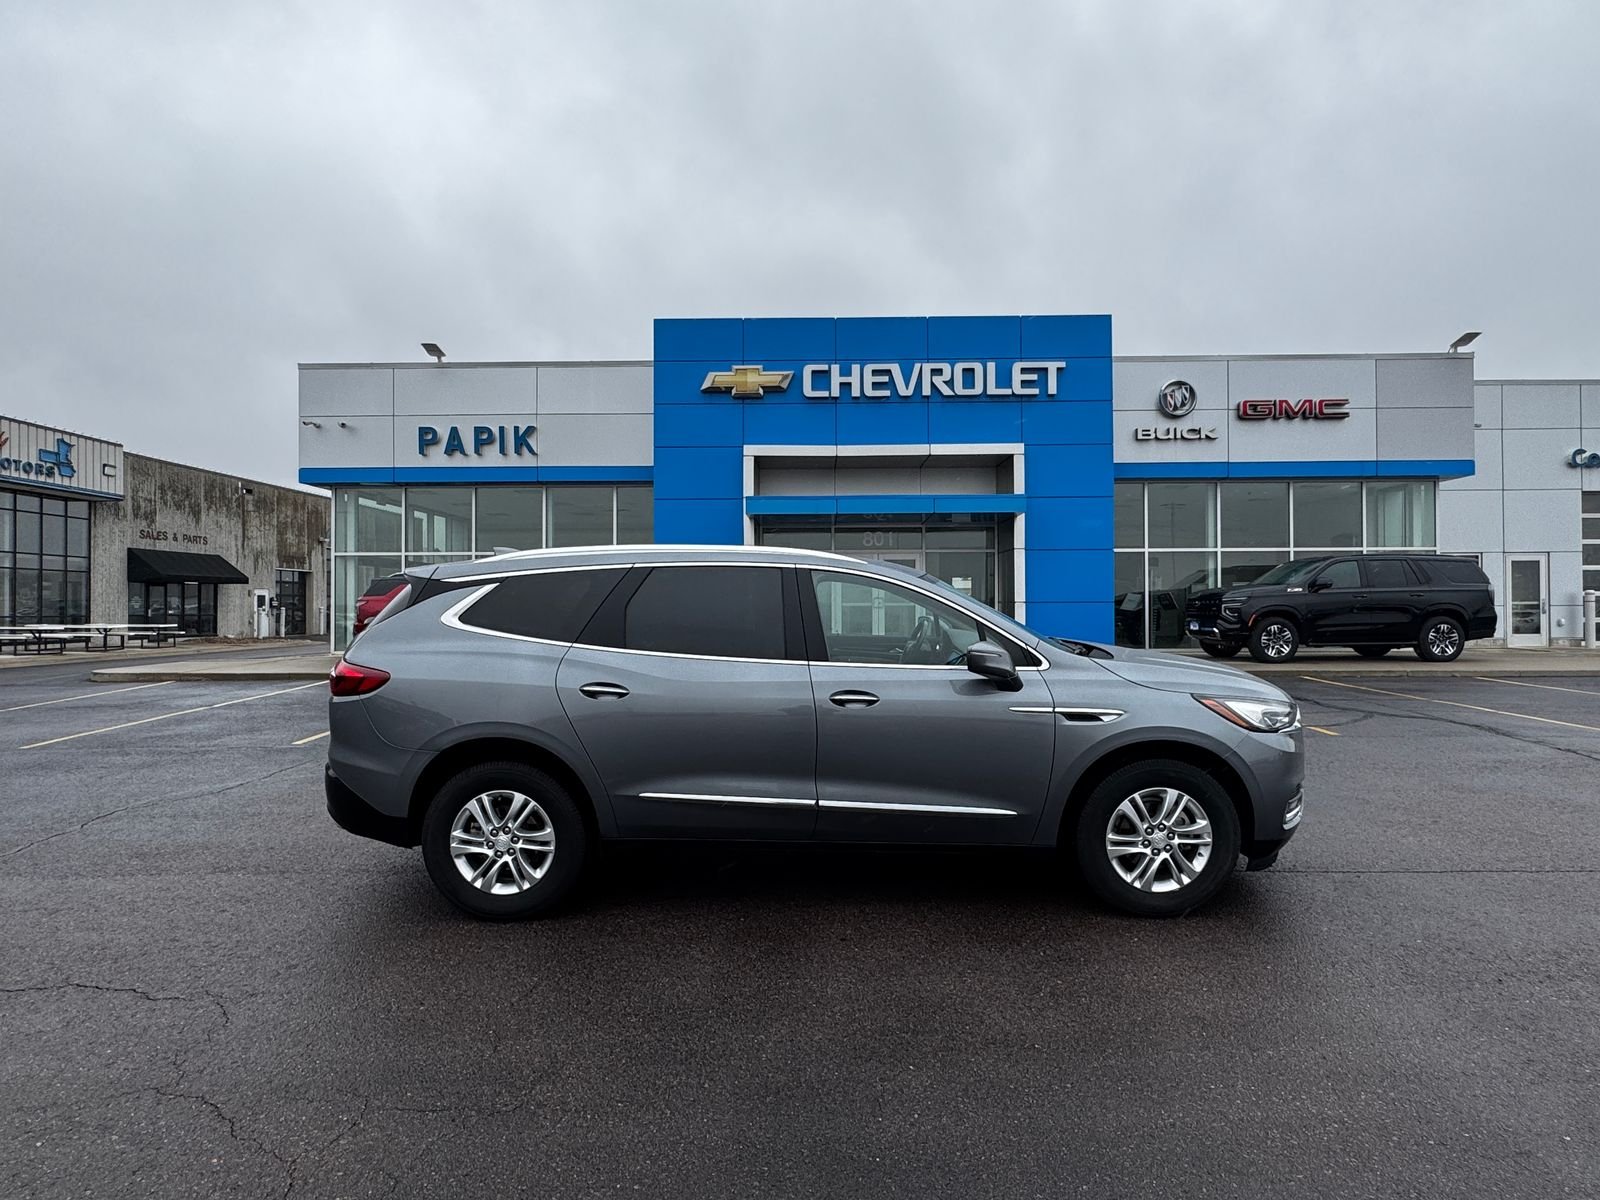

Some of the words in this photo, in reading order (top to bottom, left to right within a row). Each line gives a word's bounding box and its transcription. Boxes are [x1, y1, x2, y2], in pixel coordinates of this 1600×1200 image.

[802, 361, 1066, 398] CHEVROLET
[1238, 398, 1350, 420] GMC
[418, 425, 538, 456] PAPIK
[1135, 426, 1218, 441] BUICK
[139, 529, 168, 541] SALES
[172, 532, 178, 543] &
[182, 533, 208, 546] PARTS
[863, 531, 893, 546] 801
